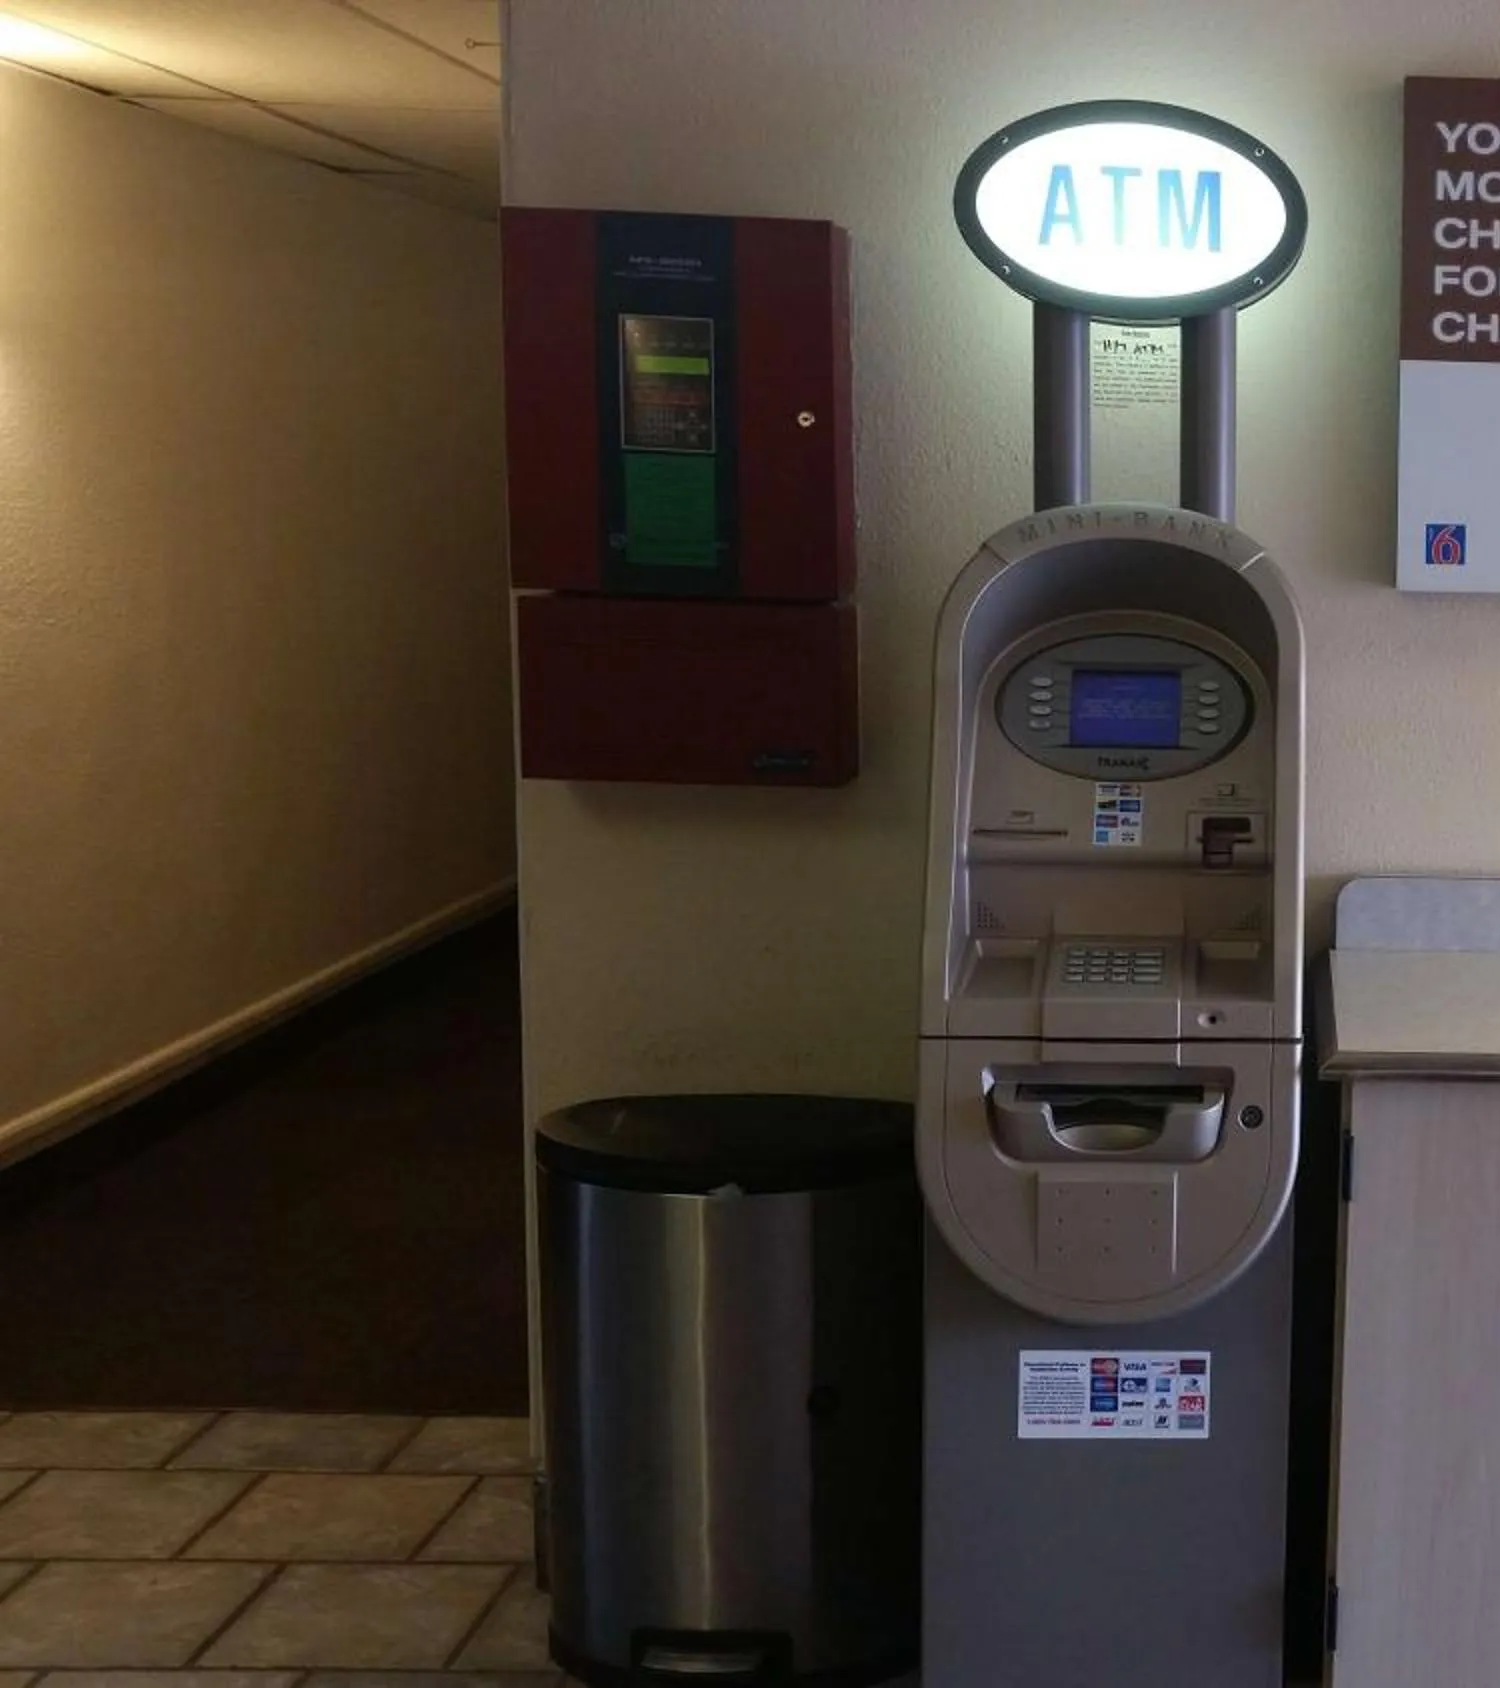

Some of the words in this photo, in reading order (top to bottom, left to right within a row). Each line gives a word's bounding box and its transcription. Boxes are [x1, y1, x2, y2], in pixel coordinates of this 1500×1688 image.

[1038, 164, 1223, 253] ATM
[1017, 511, 1237, 550] MINI-BANK
[1431, 526, 1461, 565] 6
